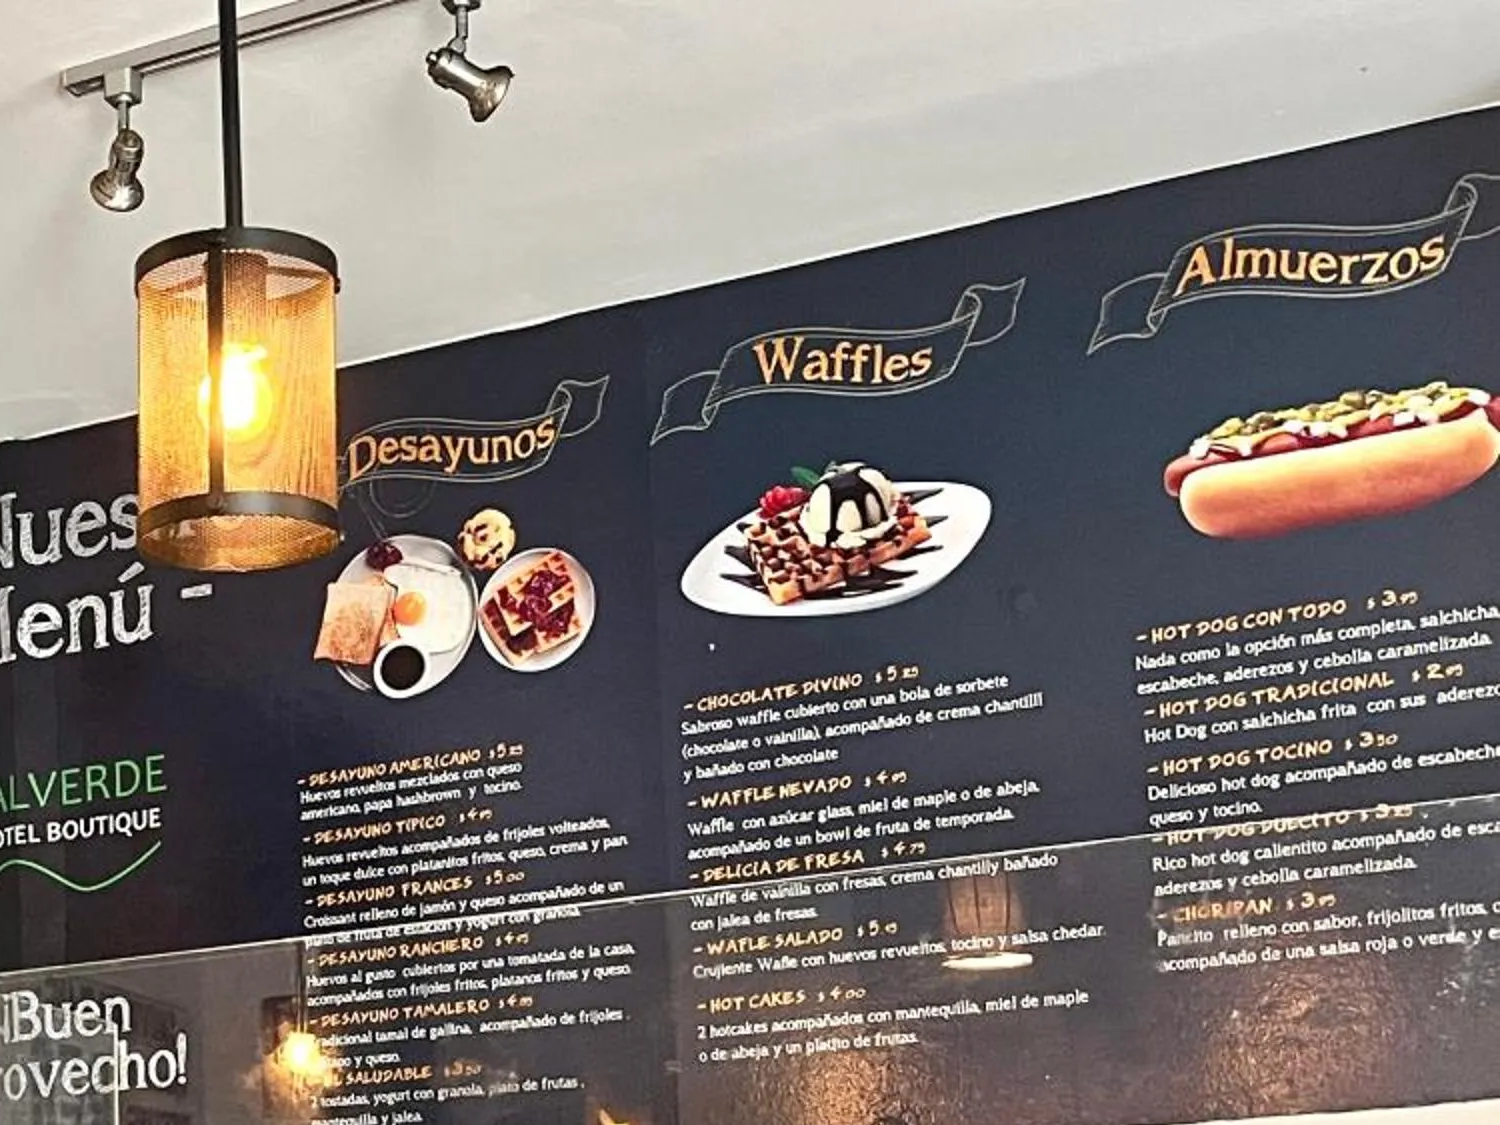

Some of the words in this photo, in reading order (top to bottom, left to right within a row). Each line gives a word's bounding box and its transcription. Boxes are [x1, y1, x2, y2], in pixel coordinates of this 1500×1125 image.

[1172, 234, 1446, 298] Almuerzos
[752, 336, 934, 385] Waffles
[349, 417, 555, 481] Desayunos
[1151, 623, 1191, 643] HOT
[1195, 615, 1238, 635] DOG
[1242, 607, 1282, 628] CON
[1287, 599, 1346, 621] TODO
[1135, 652, 1176, 670] Nada
[1179, 647, 1220, 663] como
[1225, 642, 1240, 656] la
[1244, 633, 1296, 655] opción
[1301, 627, 1332, 645] más
[1223, 661, 1294, 682] aderezos
[1298, 659, 1308, 674] y
[1313, 648, 1372, 668] cebolla
[681, 718, 732, 734] Sabroso
[736, 709, 780, 725] waffle
[783, 701, 839, 719] cubierto
[842, 697, 866, 710] con
[869, 693, 895, 706] una
[899, 685, 930, 702] bola
[933, 683, 951, 696] de
[955, 676, 1008, 693] sorbete
[697, 683, 797, 711] CHOCOLATE
[802, 673, 862, 694] DIVINO
[1159, 698, 1198, 718] HOT
[1204, 691, 1246, 711] DOG
[1251, 671, 1394, 704] TRADICIONAL
[1144, 727, 1171, 742] Hot
[1175, 723, 1206, 739] Dog
[1211, 720, 1238, 734] con
[1242, 708, 1316, 729] salchicha
[1321, 703, 1356, 718] frita
[1366, 699, 1394, 712] con
[1400, 694, 1426, 708] sus
[309, 763, 386, 786] DESAYUNO
[389, 749, 480, 773] AMERICANO
[683, 770, 692, 784] y
[695, 760, 744, 778] bañado
[747, 759, 770, 771] con
[774, 749, 838, 767] chocolate
[1163, 756, 1202, 776] HOT
[1207, 749, 1250, 769] DOG
[1255, 739, 1332, 762] TOCINO
[701, 785, 775, 807] WAFFLE
[779, 775, 851, 798] NEVADO
[1147, 782, 1216, 800] Delicioso
[1221, 776, 1246, 791] hot
[1250, 773, 1280, 788] dog
[1285, 758, 1387, 783] acompañado
[1391, 754, 1412, 769] de
[47, 807, 163, 844] BOUTIQUE
[687, 816, 734, 835] Waffle
[742, 817, 765, 829] con
[769, 809, 814, 826] azúcar
[858, 797, 888, 814] miel
[891, 795, 908, 809] de
[913, 789, 956, 807] maple
[960, 789, 970, 800] o
[973, 785, 992, 798] de
[1149, 809, 1193, 828] queso
[1197, 807, 1208, 822] y
[314, 822, 391, 844] DESAYUNO
[395, 814, 445, 832] TIPICO
[687, 838, 770, 859] acompañado
[773, 834, 791, 848] de
[795, 834, 811, 845] un
[815, 826, 850, 843] bowl
[853, 824, 870, 838] de
[875, 821, 909, 835] fruta
[913, 817, 930, 830] de
[1152, 856, 1186, 871] Rico
[1190, 853, 1216, 866] hot
[1219, 849, 1249, 865] dog
[1253, 840, 1326, 859] calientito
[1331, 826, 1436, 850] acompañado
[1441, 823, 1461, 838] de
[702, 860, 771, 881] DELICIA
[775, 857, 799, 872] DE
[804, 849, 864, 869] FRESA
[1227, 876, 1237, 891] y
[1241, 867, 1300, 886] cebolla
[316, 885, 394, 906] DESAYUNO
[401, 875, 472, 896] FRANCES
[318, 946, 396, 966] DESAYUNO
[399, 936, 483, 957] RANCHERO
[693, 962, 752, 978] Crujiente
[801, 955, 825, 967] con
[828, 949, 876, 963] huevos
[951, 936, 994, 950] tocino
[997, 935, 1007, 950] y
[1011, 929, 1048, 945] salsa
[774, 927, 842, 948] SALADO
[320, 1007, 398, 1027] DESAYUNO
[402, 998, 489, 1018] TAMALERO
[697, 1025, 706, 1039] 2
[709, 1021, 768, 1037] hotcakes
[771, 1011, 863, 1031] acompañados
[867, 1011, 891, 1022] con
[985, 995, 1016, 1011] miel
[1020, 994, 1038, 1008] de
[1043, 989, 1088, 1007] maple
[710, 996, 744, 1013] HOT
[749, 989, 805, 1008] CAKES
[345, 1065, 431, 1084] SALUDABLE
